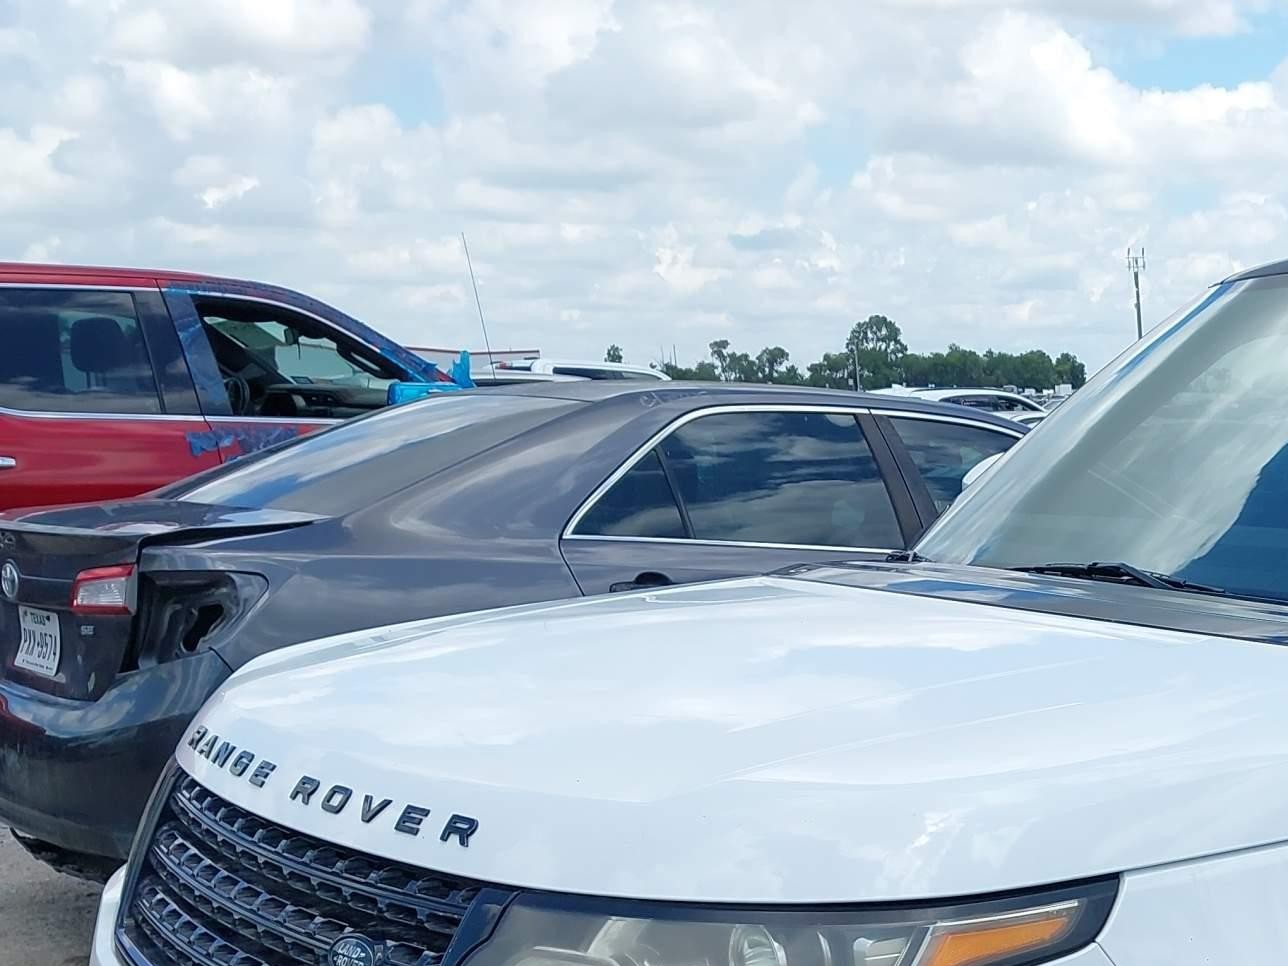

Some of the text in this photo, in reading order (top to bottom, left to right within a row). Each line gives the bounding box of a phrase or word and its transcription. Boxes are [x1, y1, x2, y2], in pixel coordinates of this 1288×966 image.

[30, 612, 46, 626] TEXAS
[186, 724, 480, 848] RANGE ROVER
[337, 942, 361, 959] LAND
